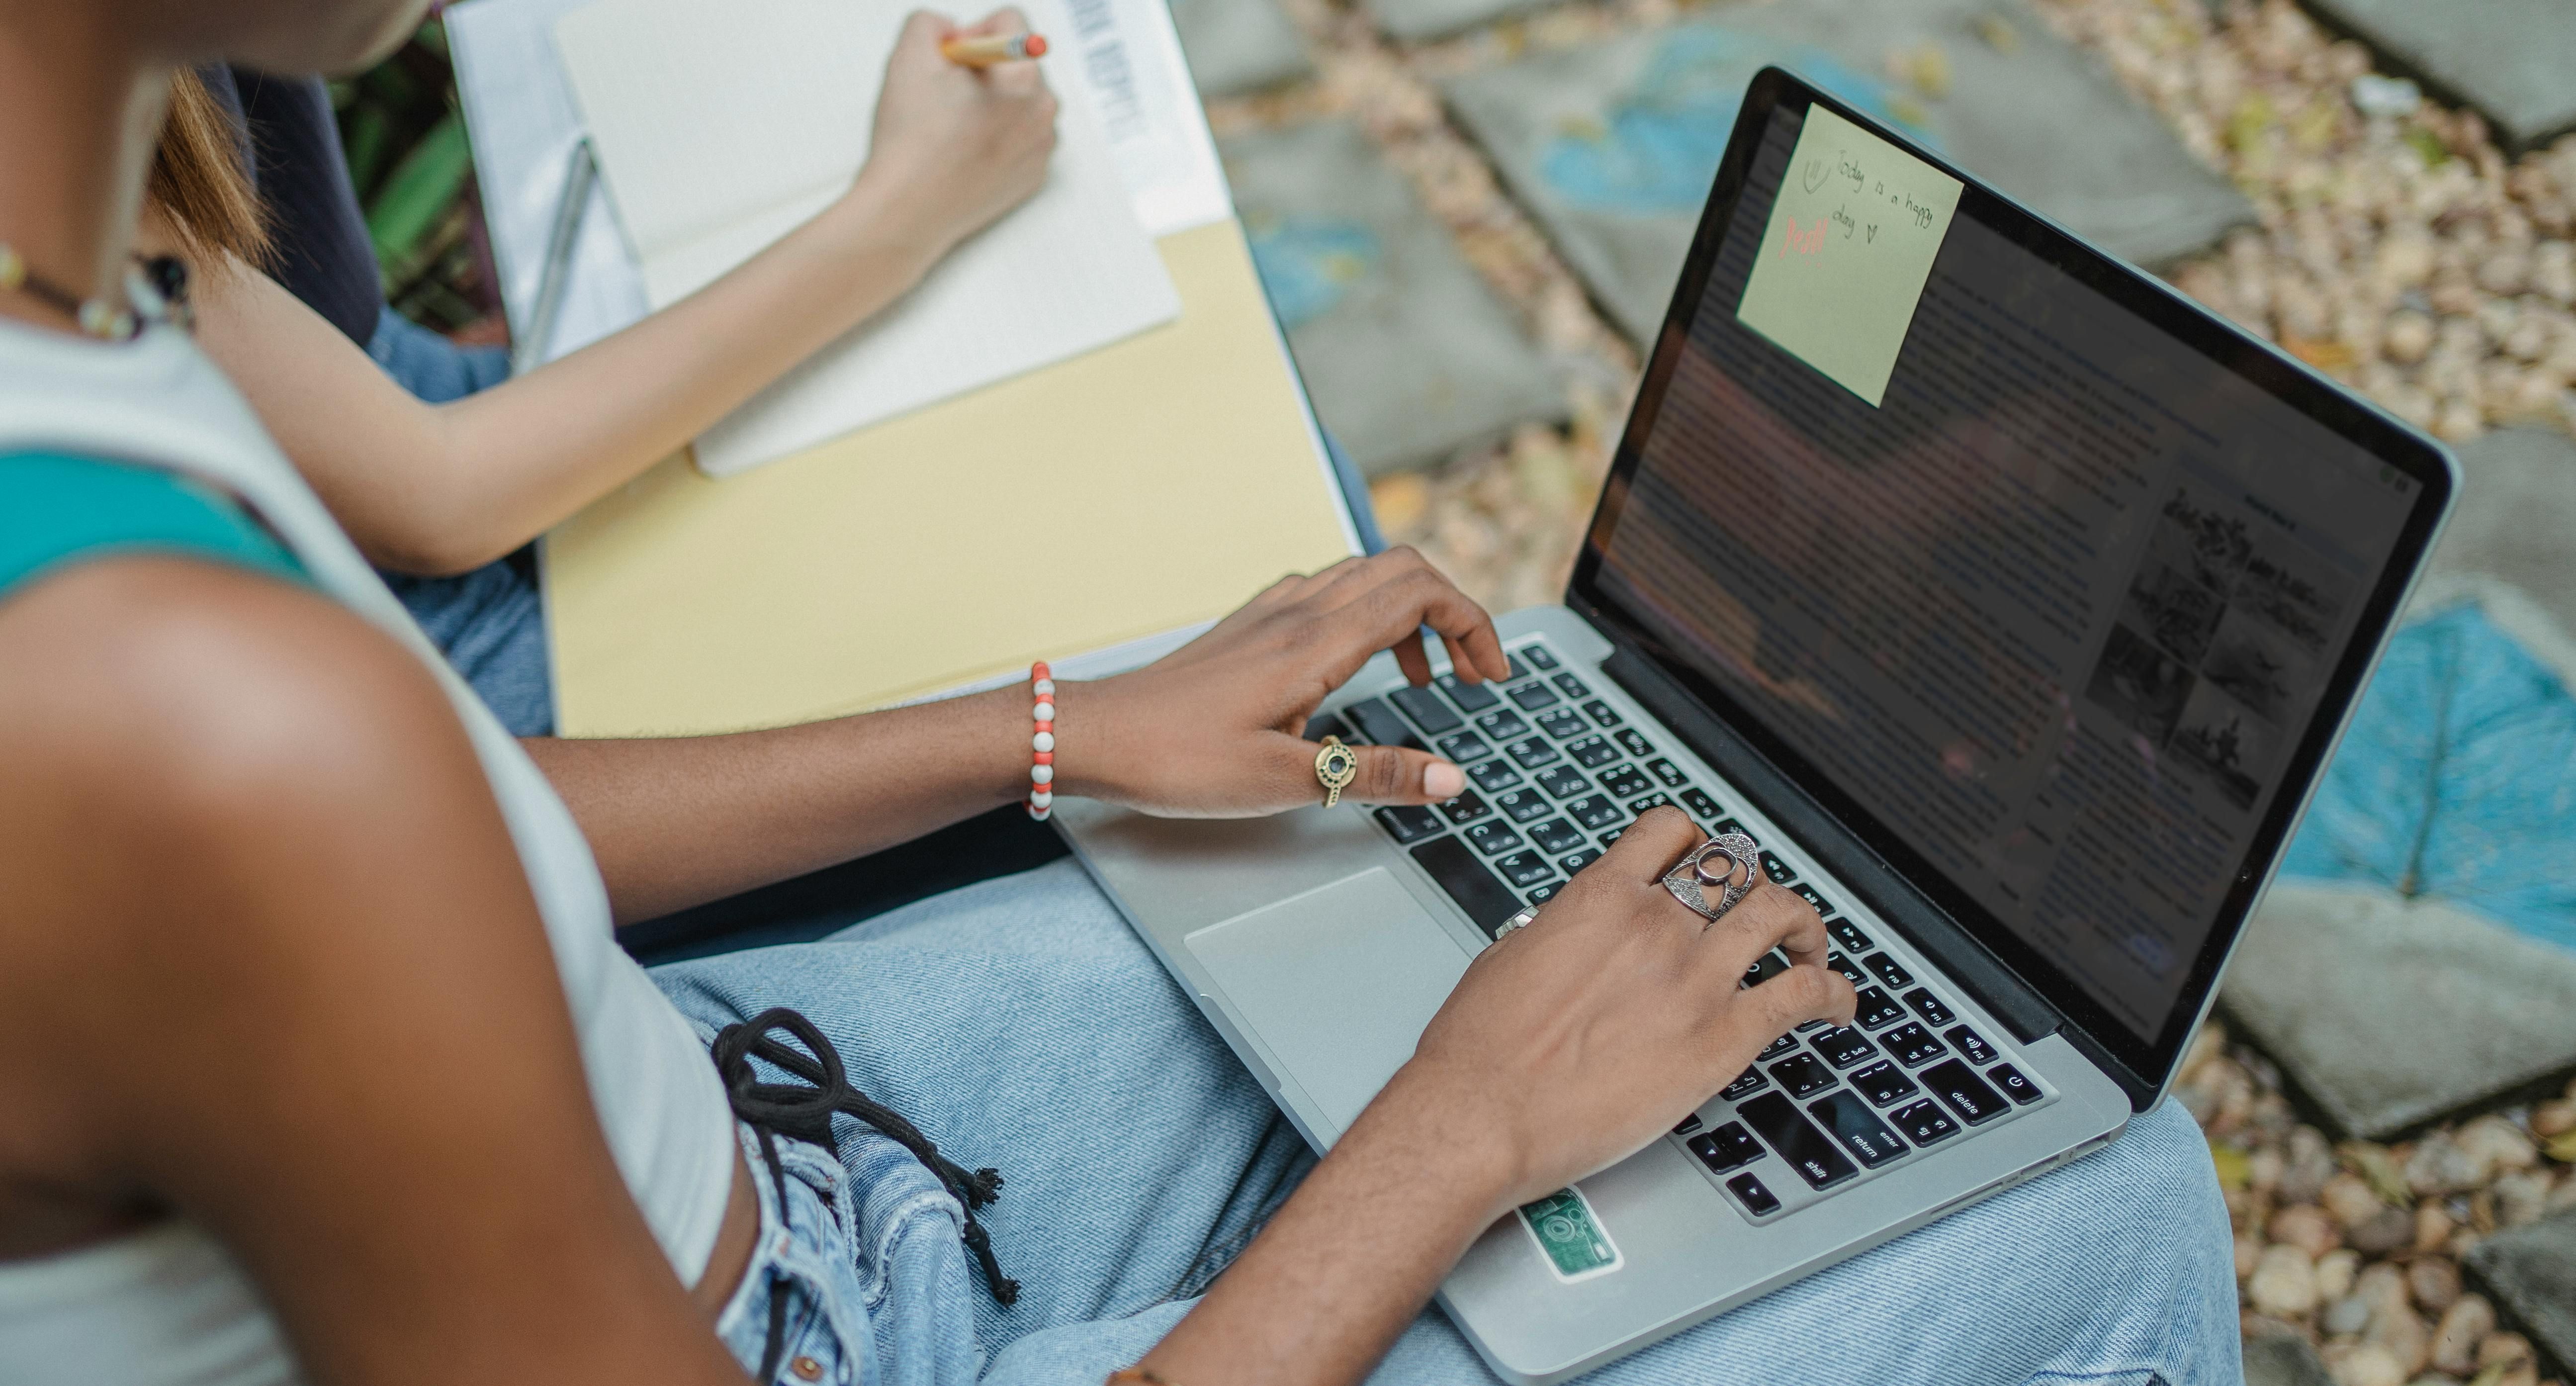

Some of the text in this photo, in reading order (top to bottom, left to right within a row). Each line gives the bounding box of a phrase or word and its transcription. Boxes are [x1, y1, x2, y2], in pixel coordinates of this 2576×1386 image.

[1837, 150, 1933, 229] Today is a happy
[1832, 203, 1856, 240] day
[1473, 826, 1489, 836] C
[1505, 856, 1519, 865] V
[1567, 856, 1583, 866] G
[1535, 888, 1549, 898] B
[1952, 1093, 1978, 1115] delete
[1852, 1134, 1877, 1158] return
[1880, 1131, 1899, 1148] enter
[1806, 1162, 1827, 1178] shift
